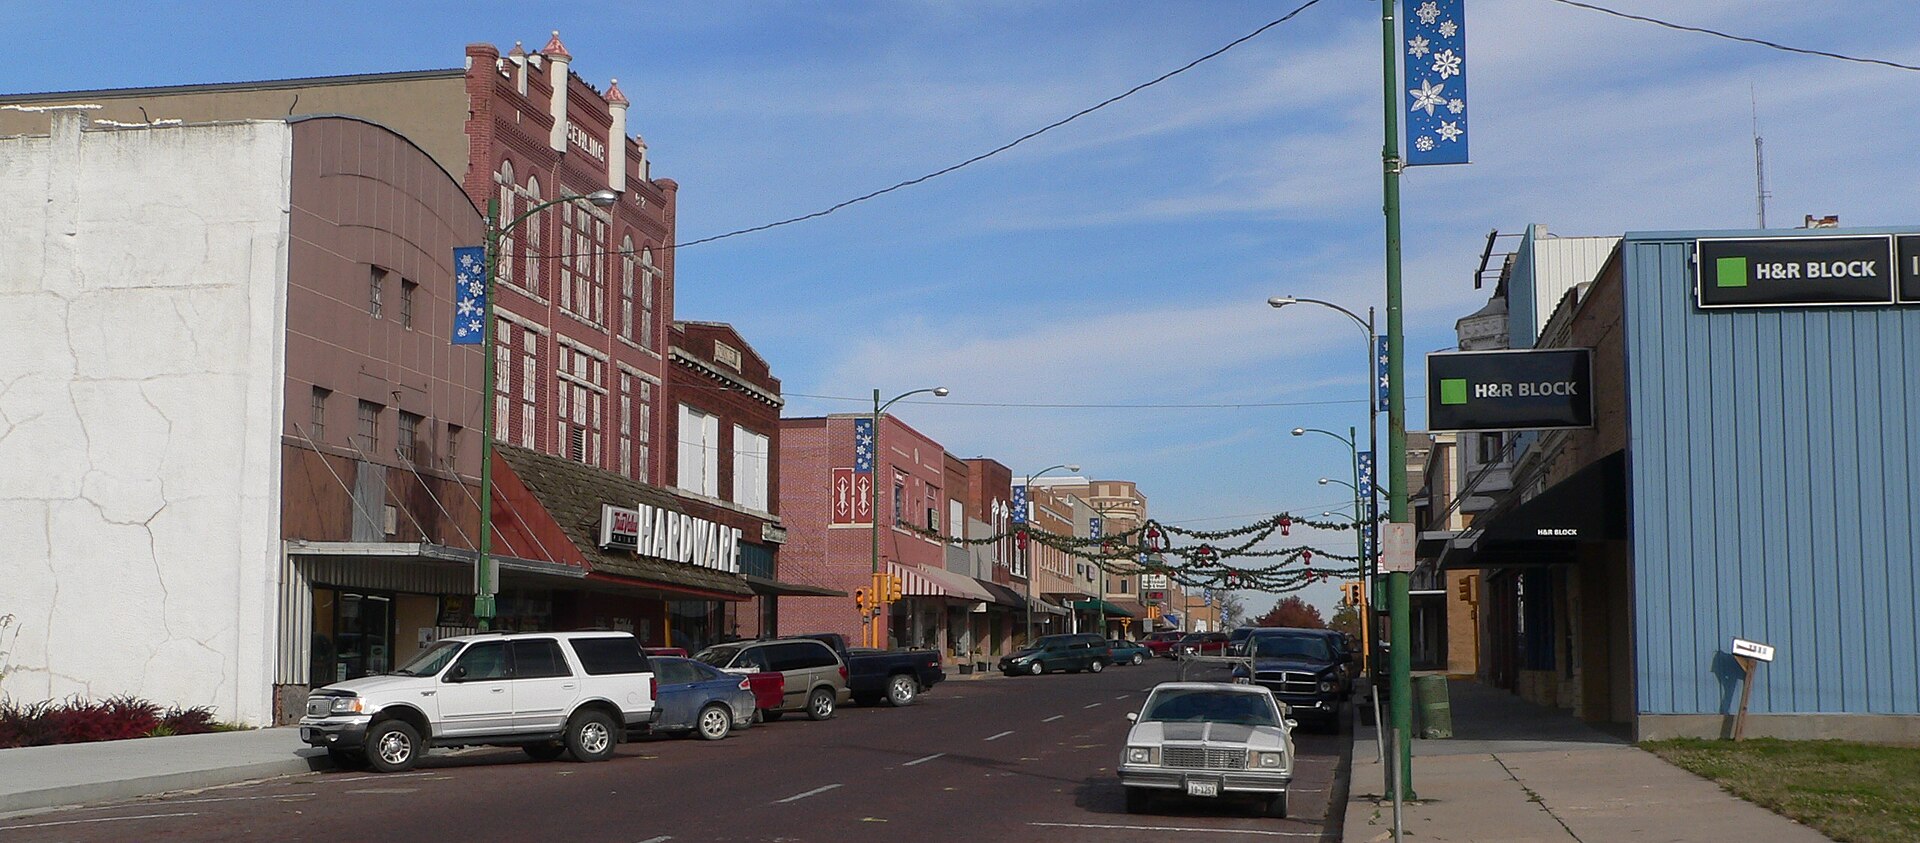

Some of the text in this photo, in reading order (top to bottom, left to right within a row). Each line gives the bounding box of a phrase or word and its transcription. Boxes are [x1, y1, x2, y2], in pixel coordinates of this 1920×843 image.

[1756, 260, 1877, 280] H&R BLOCK
[1474, 381, 1578, 398] H&R BLOCK
[637, 503, 743, 574] HARDWARE
[1537, 528, 1578, 536] H&R BLOCK
